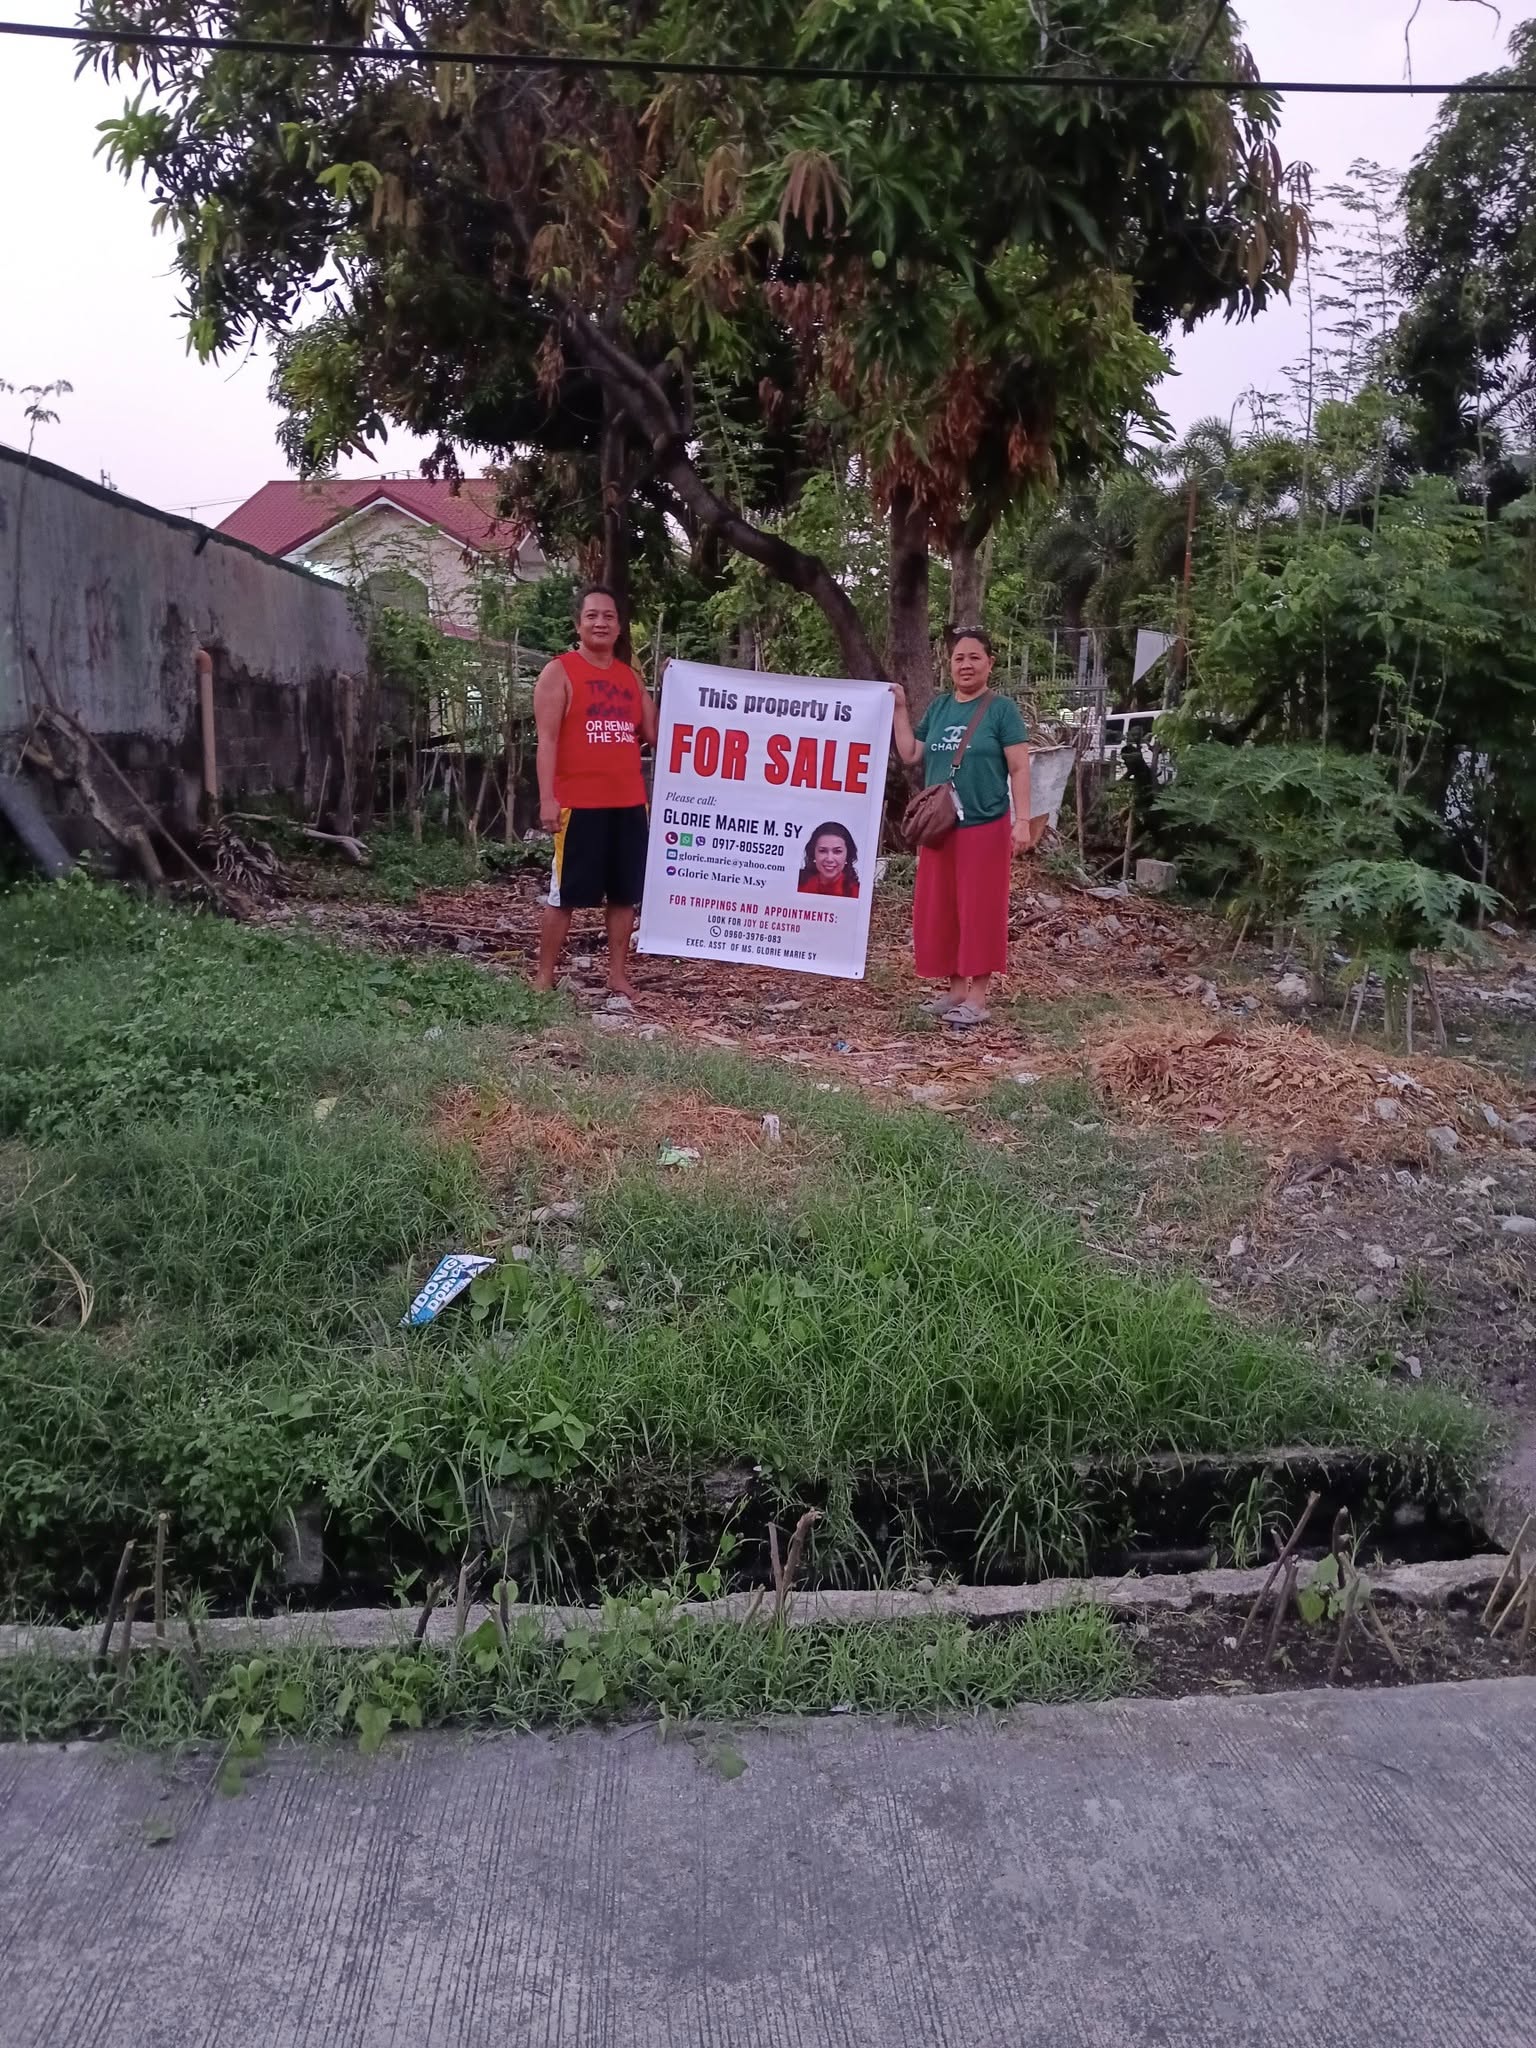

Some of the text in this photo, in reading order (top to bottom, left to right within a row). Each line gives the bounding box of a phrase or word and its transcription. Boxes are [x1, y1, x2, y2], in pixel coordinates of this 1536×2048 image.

[698, 687, 852, 722] This property is
[585, 720, 602, 731] OR
[586, 731, 612, 743] THE
[930, 743, 972, 751] CHAN
[669, 723, 871, 794] FOR SALE
[665, 792, 717, 806] Please call:
[664, 808, 803, 839] GLORIE MARIE M. SY
[712, 838, 784, 857] 0917-8055220
[678, 852, 785, 872] glorie.marie@yahoo.com
[677, 867, 709, 880] Glorie
[711, 871, 741, 884] Marie
[669, 894, 838, 924] FOR TRIPPINGS AND APPOINTMENTS:
[707, 914, 801, 933] LOOK FOR JOY DE CASTRO
[723, 929, 782, 944] 0960-3976-083
[686, 937, 817, 961] EXEC. ASST OF MS. GLORIE MARIE SY
